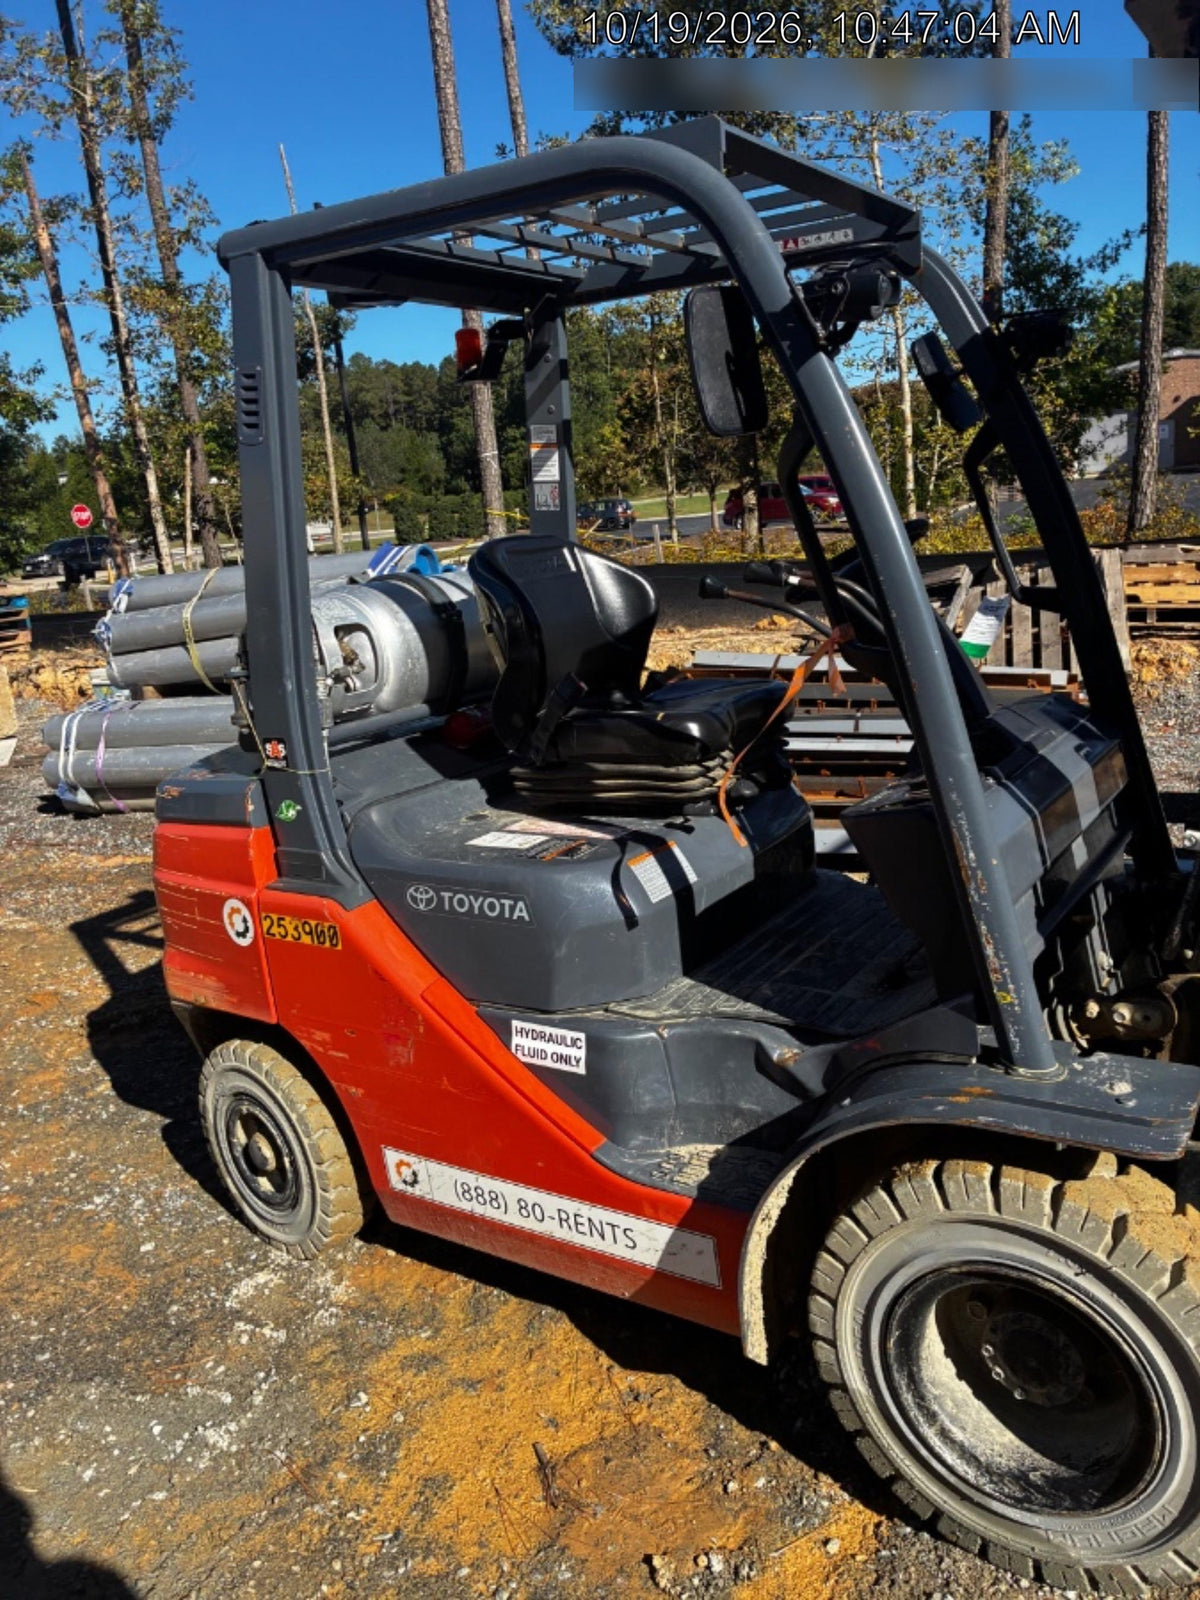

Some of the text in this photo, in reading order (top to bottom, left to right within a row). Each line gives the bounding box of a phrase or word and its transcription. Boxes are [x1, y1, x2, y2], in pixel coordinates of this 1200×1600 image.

[441, 892, 530, 921] TOYOTA
[263, 915, 340, 948] 253900
[515, 1026, 583, 1049] HYDRAULIC
[515, 1043, 581, 1068] FLUID ONLY
[454, 1179, 638, 1251] (888) 80-RENTS
